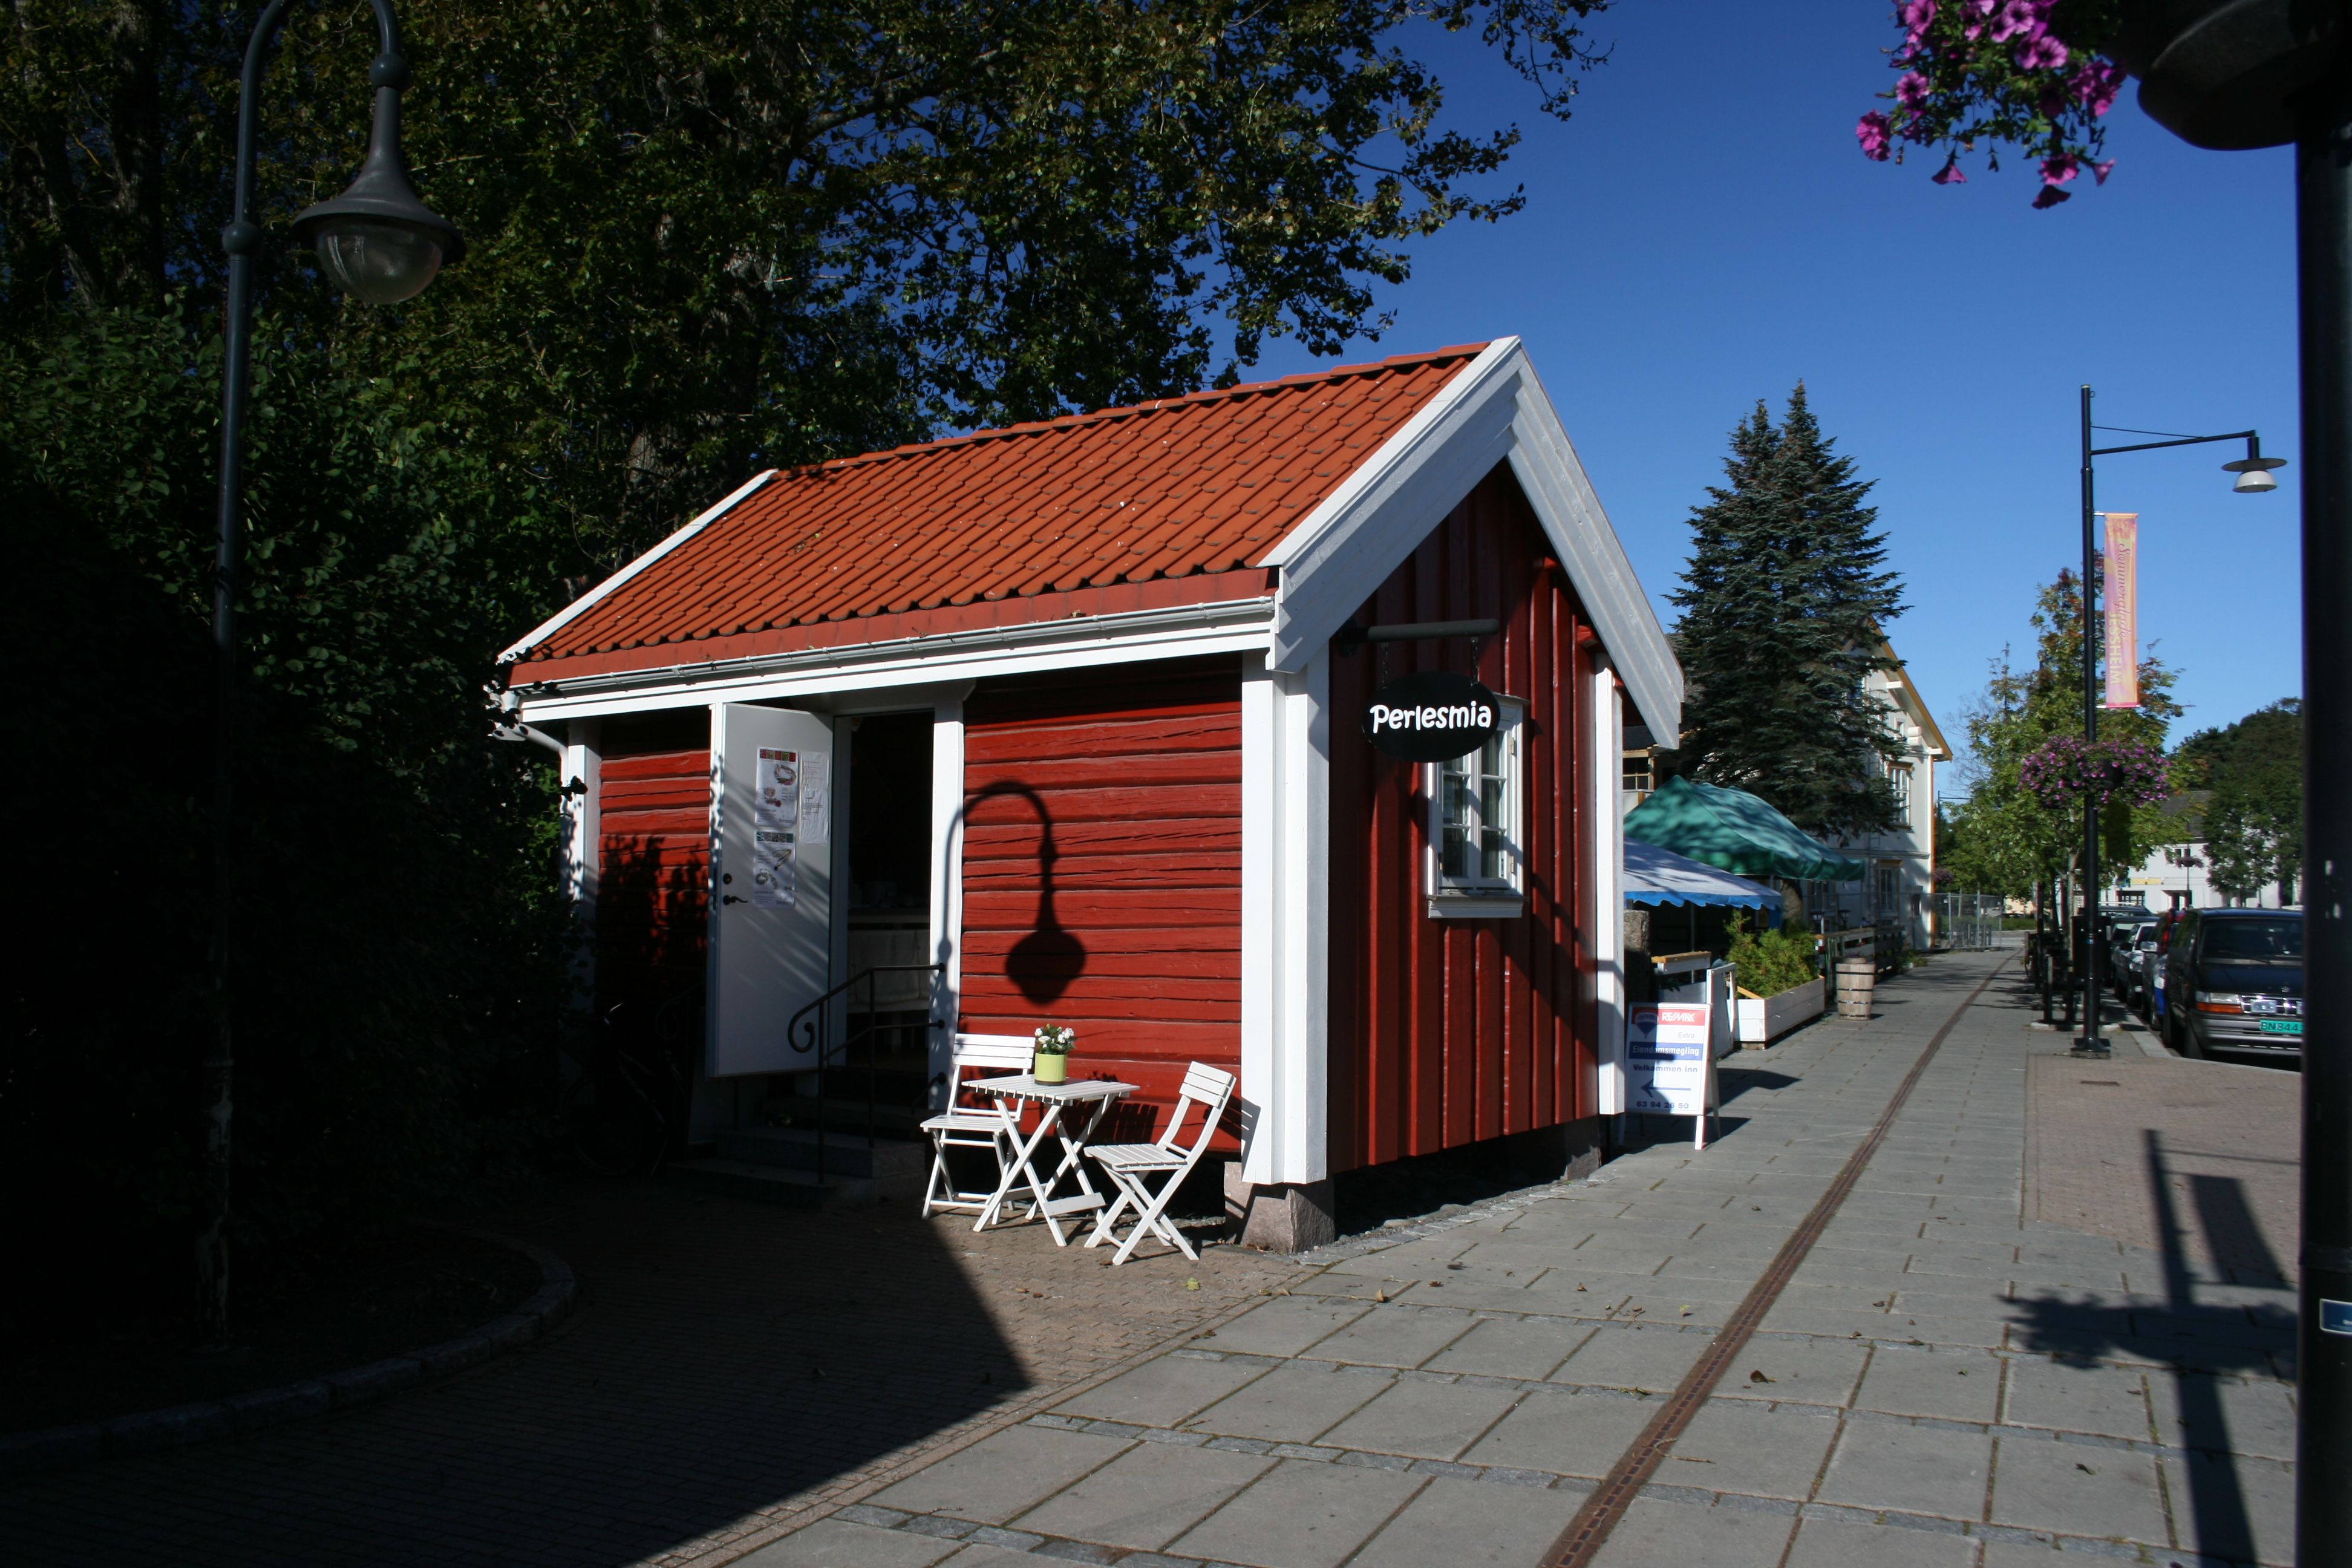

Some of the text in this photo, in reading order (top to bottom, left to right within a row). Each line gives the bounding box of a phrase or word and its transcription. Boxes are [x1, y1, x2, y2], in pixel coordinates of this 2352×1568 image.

[2108, 610, 2122, 685] JESSHEIM
[1369, 700, 1492, 734] Perlesmia
[1632, 1045, 1699, 1056] Eiendomsmegling
[1633, 1064, 1682, 1073] Velkommen
